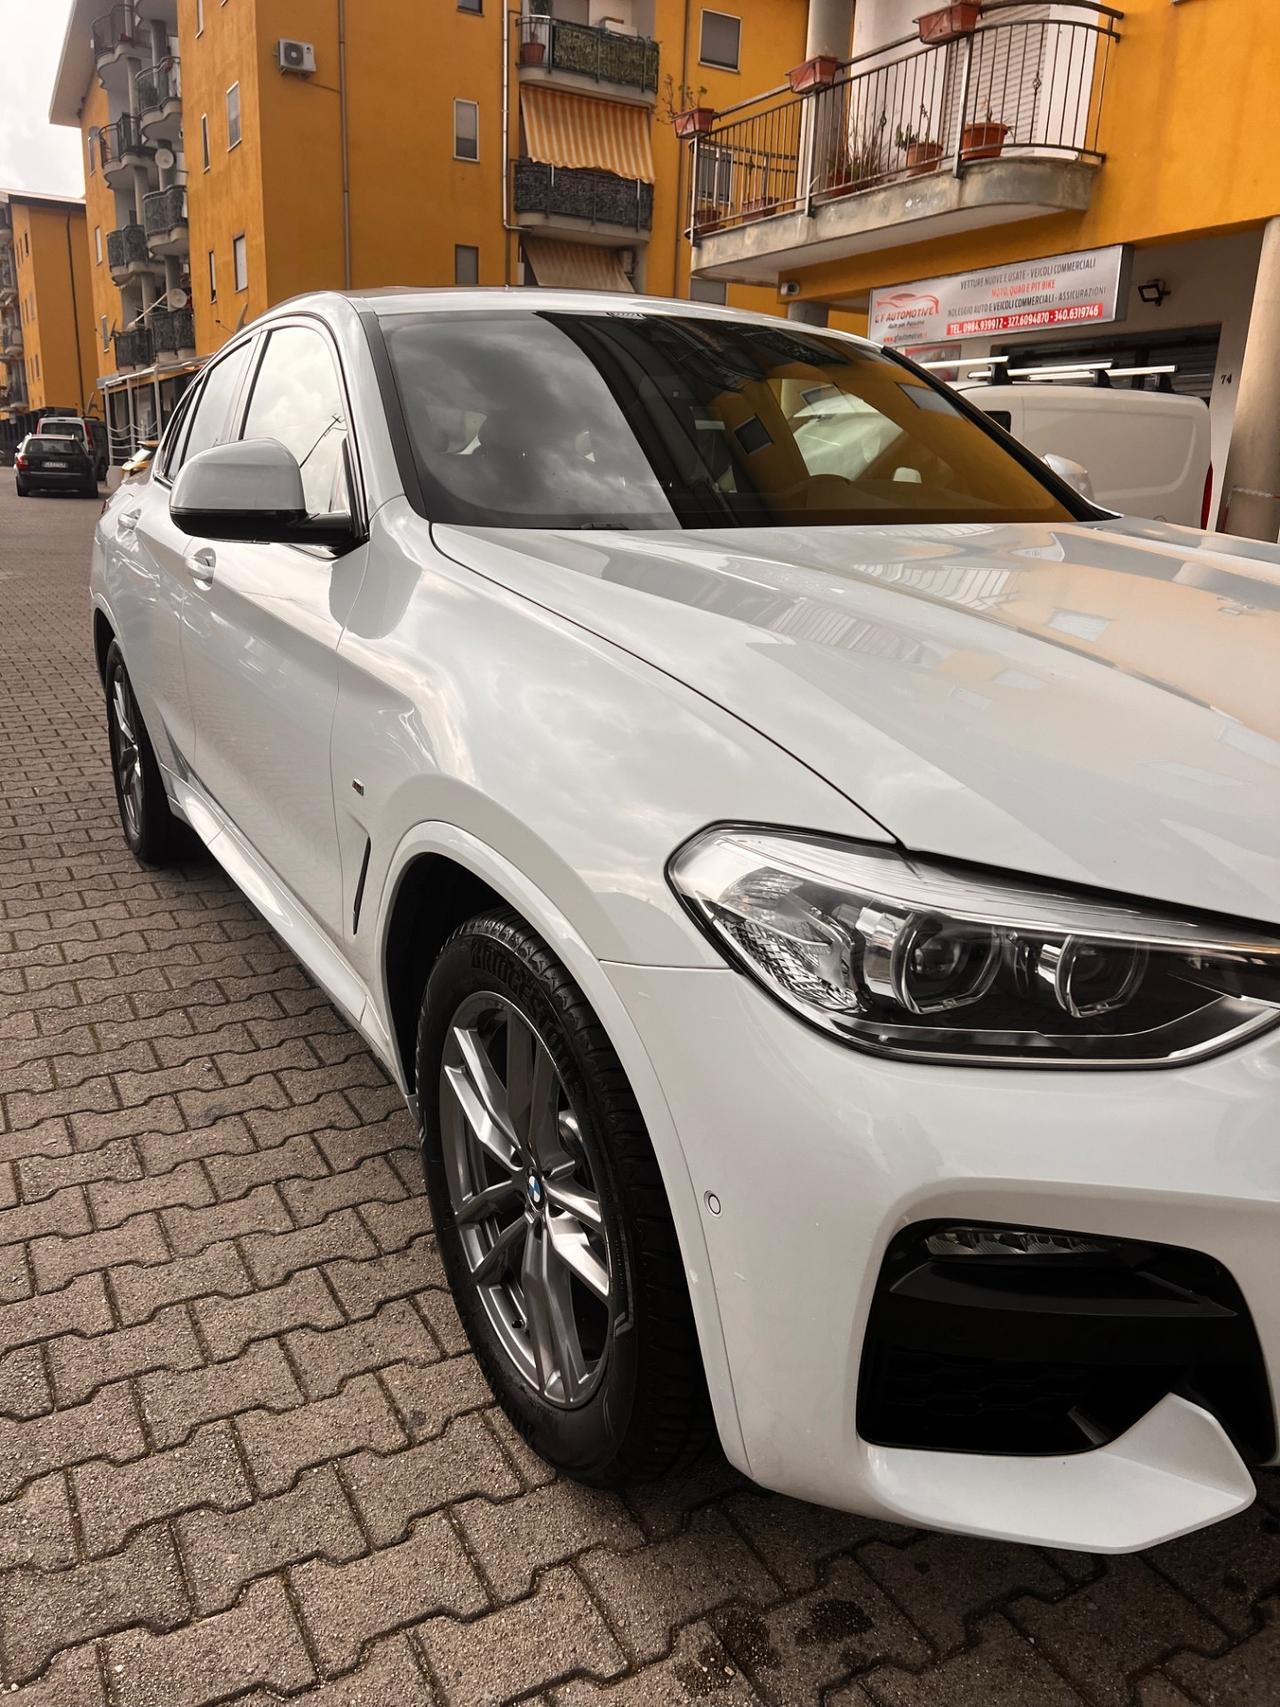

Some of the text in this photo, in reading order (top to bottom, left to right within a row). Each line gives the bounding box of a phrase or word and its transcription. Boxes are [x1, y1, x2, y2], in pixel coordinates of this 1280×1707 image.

[1030, 265, 1053, 278] VEICOLI
[1054, 258, 1096, 275] COMMERCIALI
[993, 299, 1014, 311] VEICOLI
[1015, 294, 1054, 308] COMMERCIALI
[1058, 285, 1106, 301] ASSICURAZIONI
[886, 307, 934, 322] AUTOMOTIVE
[1054, 304, 1099, 321] 340.6319746
[1221, 374, 1232, 384] 74
